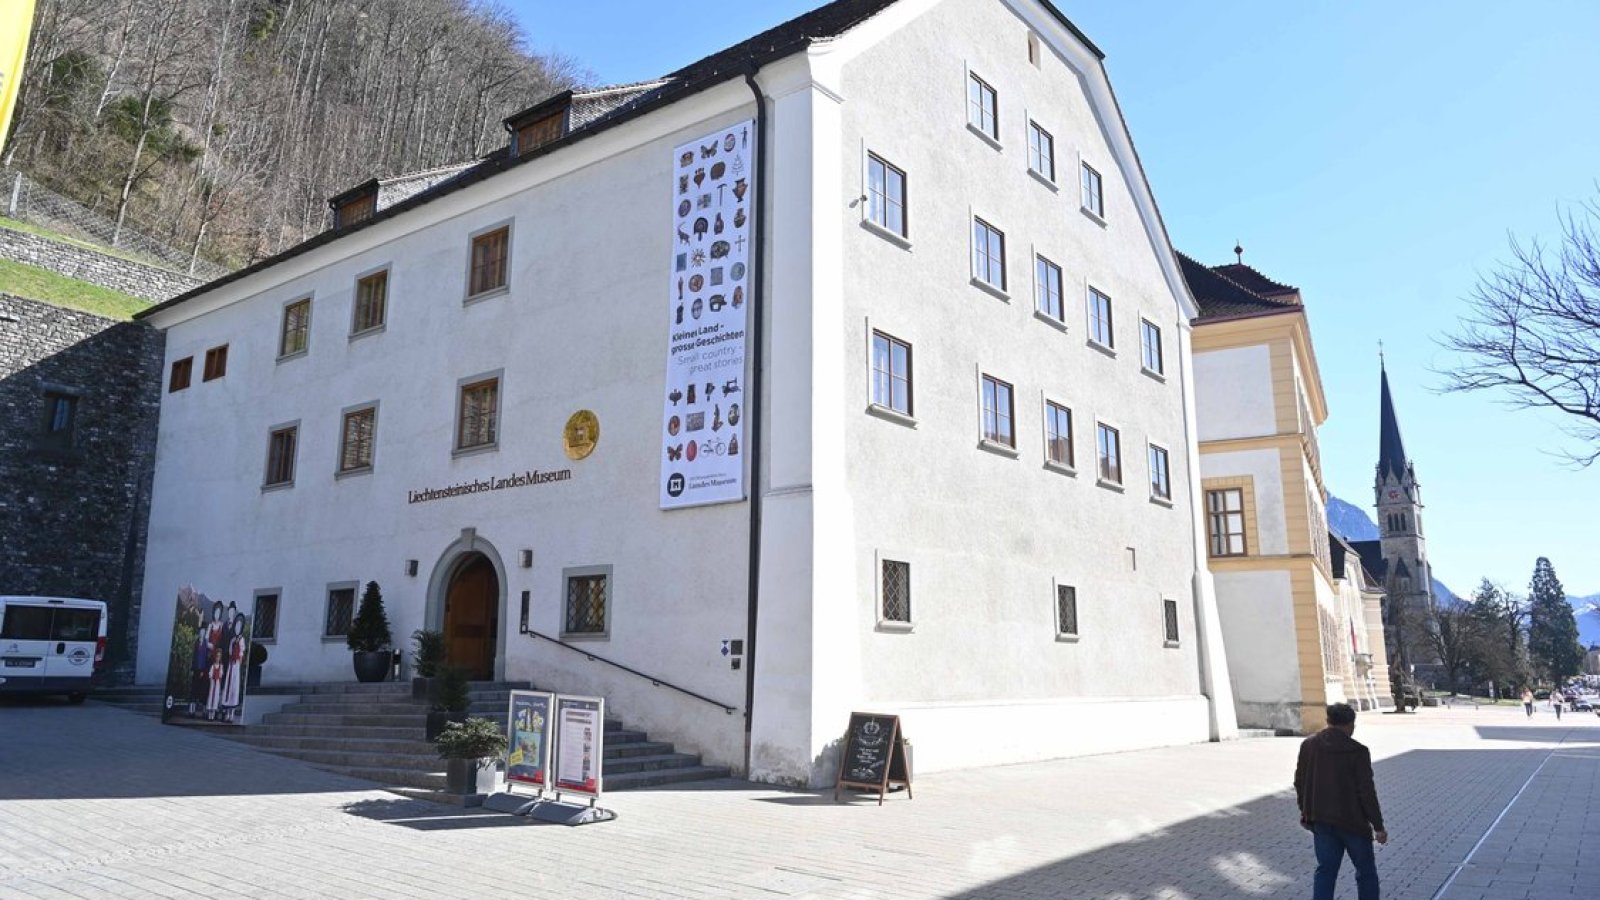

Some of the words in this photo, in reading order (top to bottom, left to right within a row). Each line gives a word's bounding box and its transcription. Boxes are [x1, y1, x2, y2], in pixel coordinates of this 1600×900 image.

[699, 323, 719, 335] Land
[695, 330, 745, 347] Geschichten
[678, 351, 699, 365] Small
[702, 346, 736, 360] country
[689, 362, 712, 375] great
[713, 357, 743, 369] stories
[408, 478, 489, 504] Liechtensteinisches
[490, 473, 526, 491] Landes
[526, 469, 571, 485] Museum
